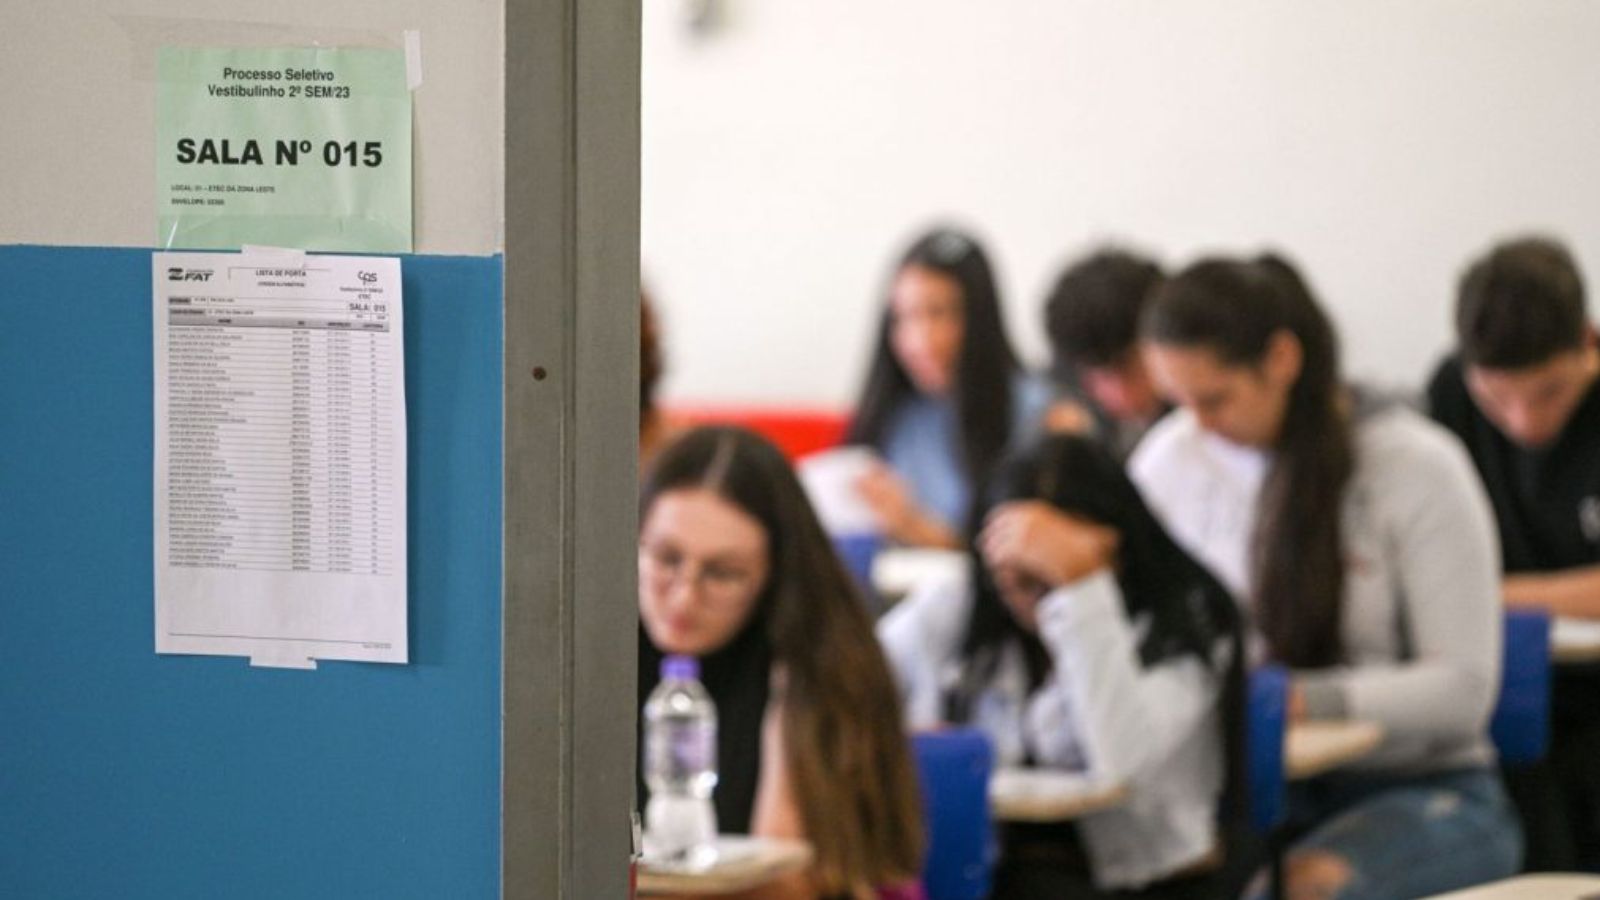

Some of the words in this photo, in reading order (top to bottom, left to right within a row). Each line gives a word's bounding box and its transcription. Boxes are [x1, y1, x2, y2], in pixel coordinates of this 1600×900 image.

[223, 67, 282, 80] Processo
[285, 69, 335, 81] Seletivo
[208, 84, 285, 98] Vestibulinho
[304, 86, 350, 99] SEM/23
[176, 138, 263, 165] SALA
[276, 140, 312, 165] Nº
[323, 141, 383, 167] 015
[185, 272, 214, 282] FAT
[284, 270, 307, 278] PORTA
